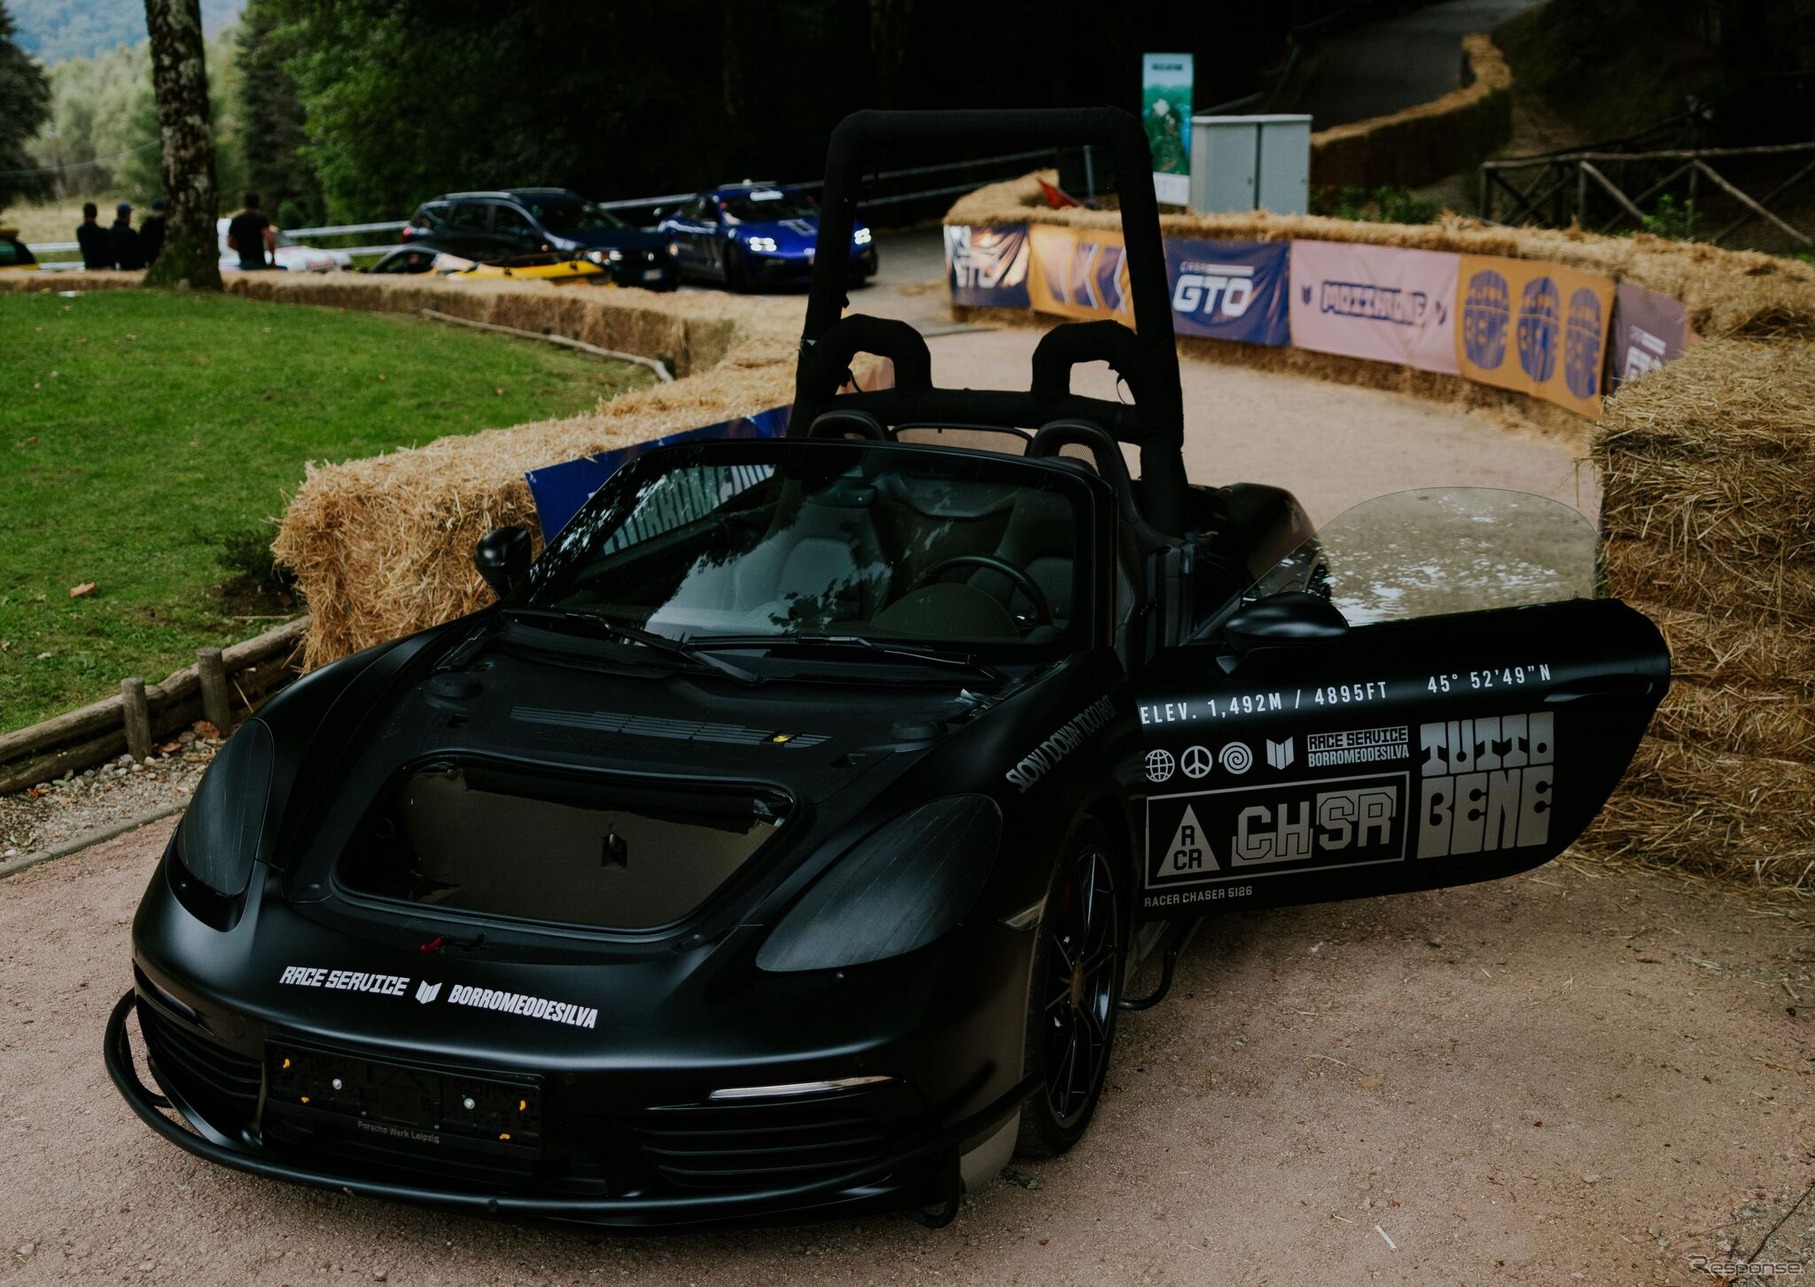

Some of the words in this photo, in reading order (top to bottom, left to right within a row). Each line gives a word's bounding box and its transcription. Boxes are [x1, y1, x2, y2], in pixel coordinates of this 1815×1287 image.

[1172, 274, 1254, 318] GTO
[1139, 702, 1197, 725] ELEV.
[1207, 692, 1282, 718] 1,492M
[1294, 689, 1301, 710] /
[1314, 681, 1387, 706] 4895FT
[1427, 673, 1458, 694] 45°
[1308, 732, 1344, 751] RACE
[1346, 726, 1408, 747] SERVICE
[1420, 711, 1554, 777] TUTTO
[1308, 744, 1410, 768] BORROMEODESILVA
[1417, 765, 1554, 859] BENE
[1180, 825, 1196, 847] R
[1172, 849, 1203, 871] CR
[1144, 893, 1180, 908] RACER
[1182, 888, 1225, 904] CHASER
[279, 965, 329, 987] RACE
[324, 969, 411, 997] SERVICE
[447, 984, 599, 1030] BORROMEODESILVA
[357, 1120, 389, 1135] Porsche
[389, 1126, 410, 1138] Werk
[410, 1130, 441, 1145] Leipzig
